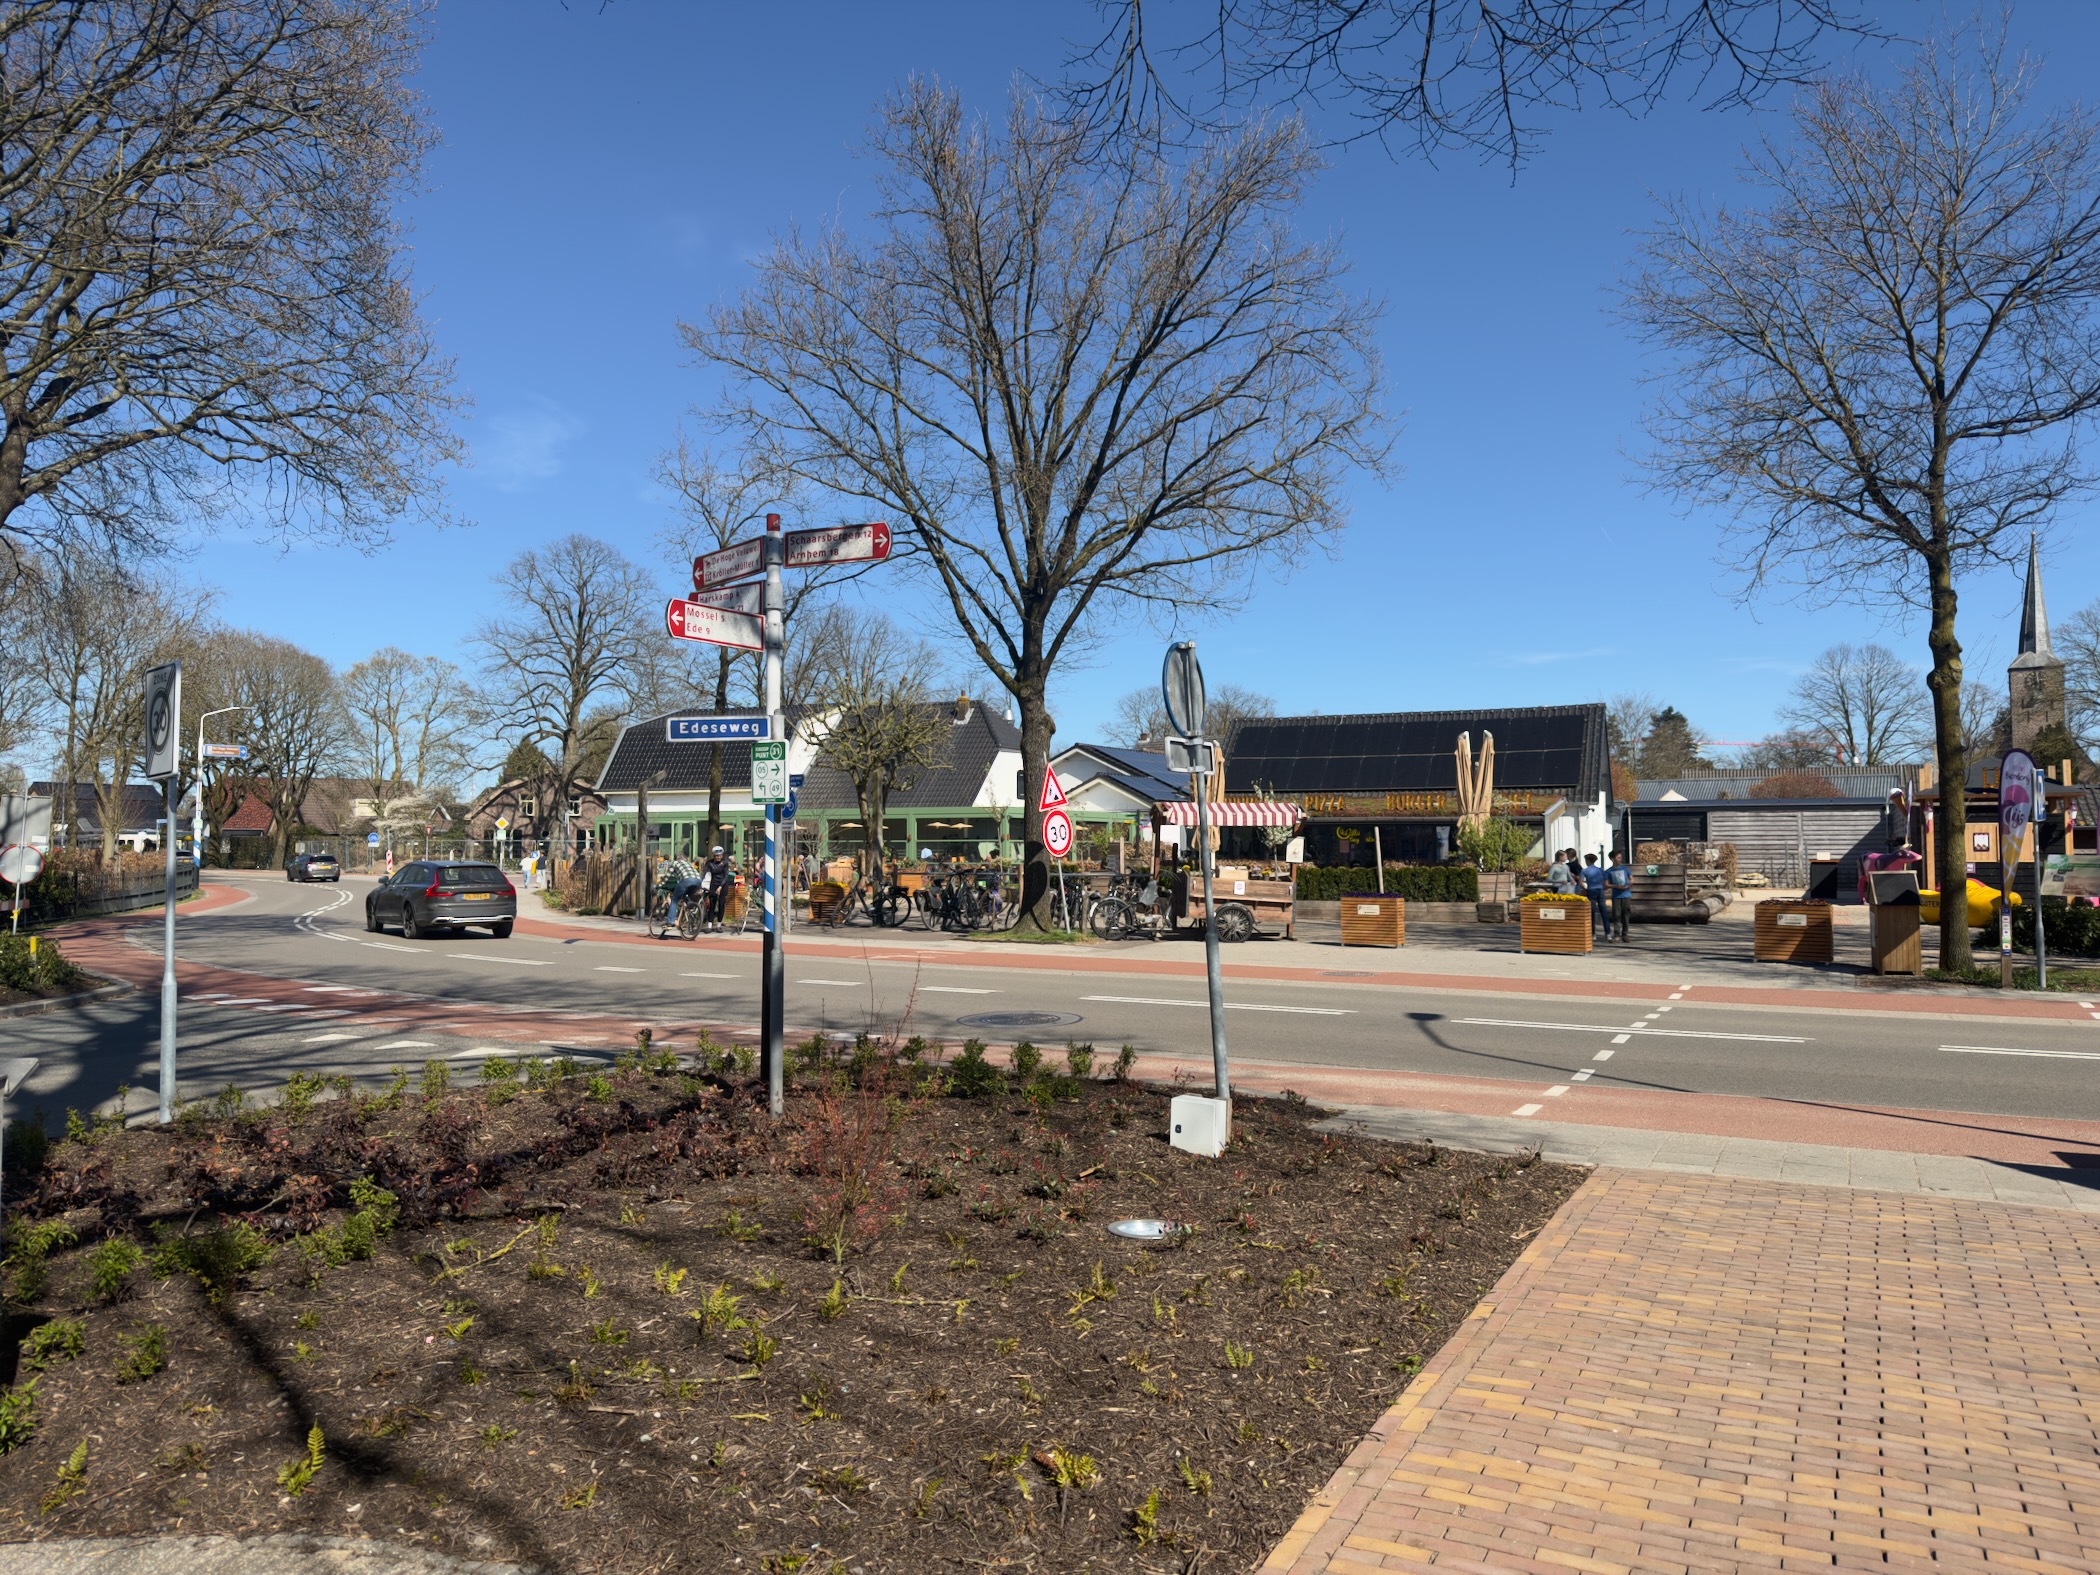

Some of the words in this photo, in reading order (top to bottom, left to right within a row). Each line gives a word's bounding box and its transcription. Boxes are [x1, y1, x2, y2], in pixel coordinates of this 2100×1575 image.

[789, 531, 860, 546] Schaarsbergen
[863, 530, 872, 538] 12
[712, 556, 720, 565] De
[721, 552, 735, 562] Hoge
[790, 549, 827, 560] Arnhem
[830, 548, 839, 556] 18
[713, 561, 754, 578] Kröller-Müller
[699, 593, 733, 603] Harskamp
[686, 607, 718, 621] Mossel
[720, 614, 725, 622] 5
[686, 622, 702, 633] Ede
[705, 627, 710, 635] 9
[153, 672, 167, 685] ZONE
[153, 710, 167, 734] 30
[679, 722, 759, 736] Edeseweg
[772, 747, 780, 755] 31
[757, 766, 766, 774] 05
[771, 784, 780, 792] 49
[1305, 793, 1345, 811] PIZZA
[1387, 792, 1447, 812] BURGER
[1050, 824, 1067, 843] 30
